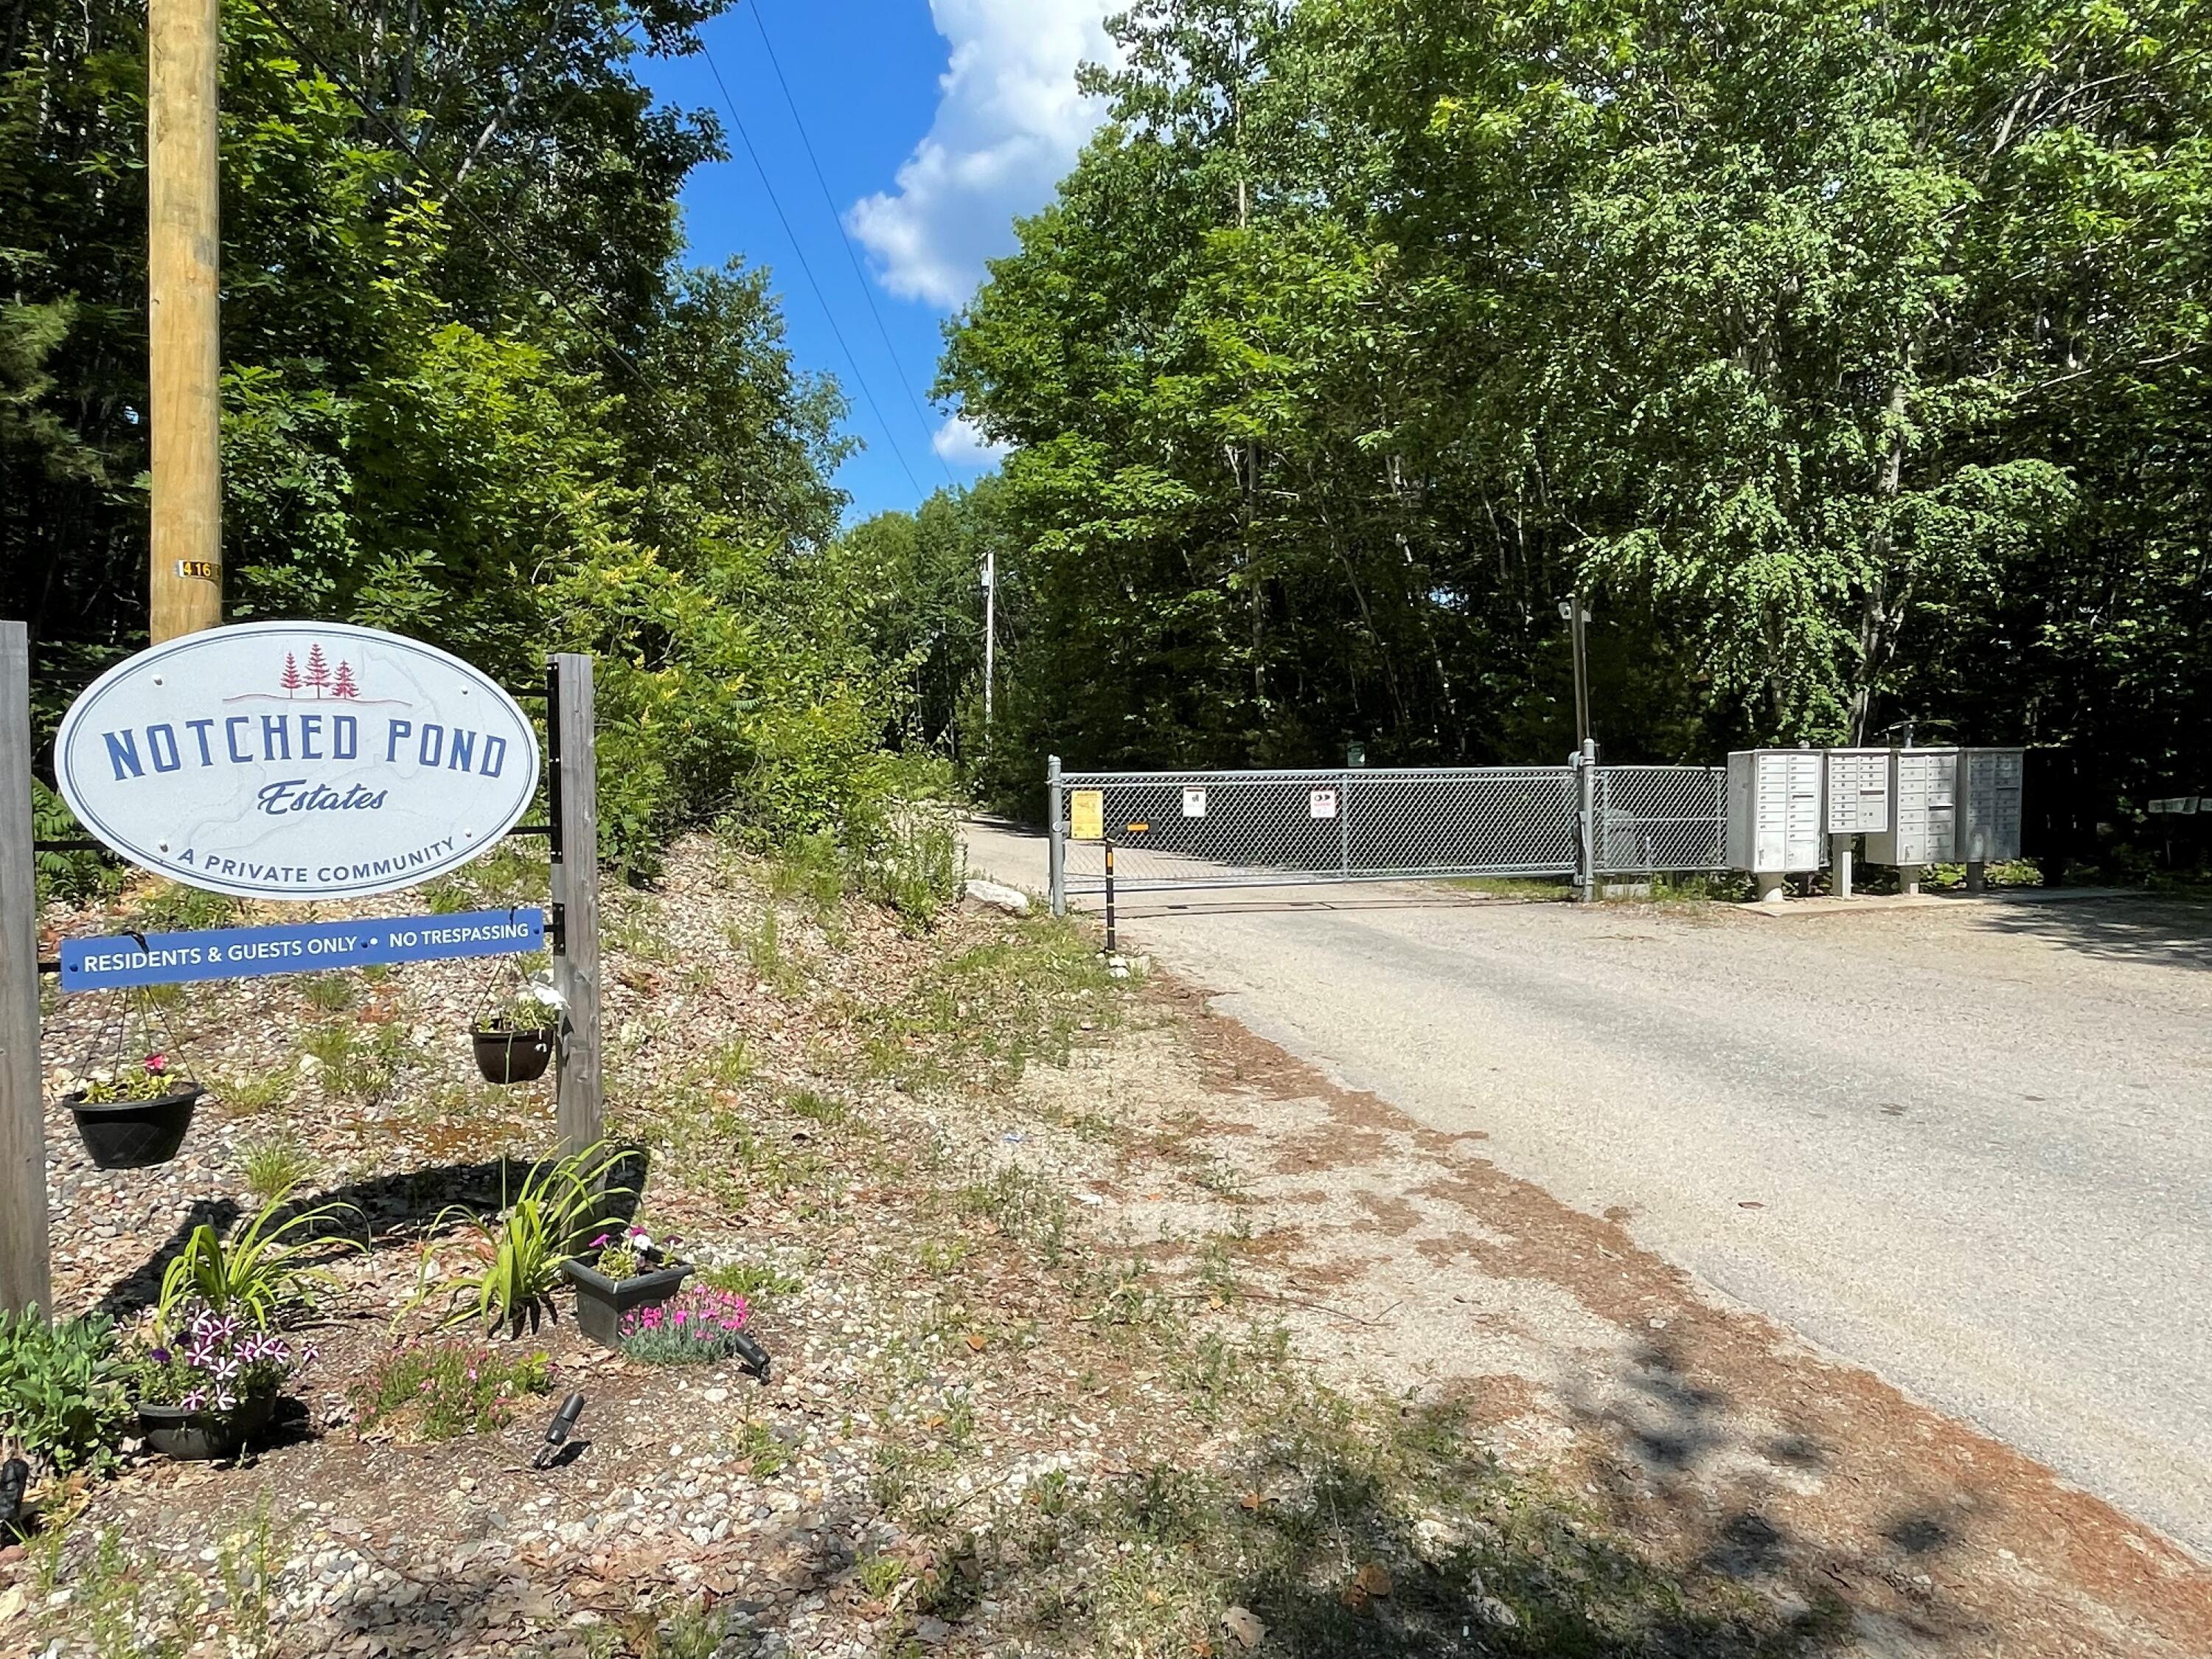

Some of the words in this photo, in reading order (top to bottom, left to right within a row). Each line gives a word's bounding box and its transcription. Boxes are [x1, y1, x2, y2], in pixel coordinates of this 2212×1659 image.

[184, 561, 211, 577] 416
[101, 714, 357, 781] NOTCHED
[386, 719, 507, 779] POND
[257, 779, 388, 815] Estates
[177, 848, 194, 865] A
[204, 855, 307, 883] PRIVATE
[317, 836, 454, 883] COMMUNITY
[84, 947, 201, 973] RESIDENTS
[207, 947, 222, 962] &
[228, 940, 302, 961] GUESTS
[307, 935, 358, 955] ONLY
[389, 931, 417, 947] NO
[422, 923, 529, 945] TRESPASSING
